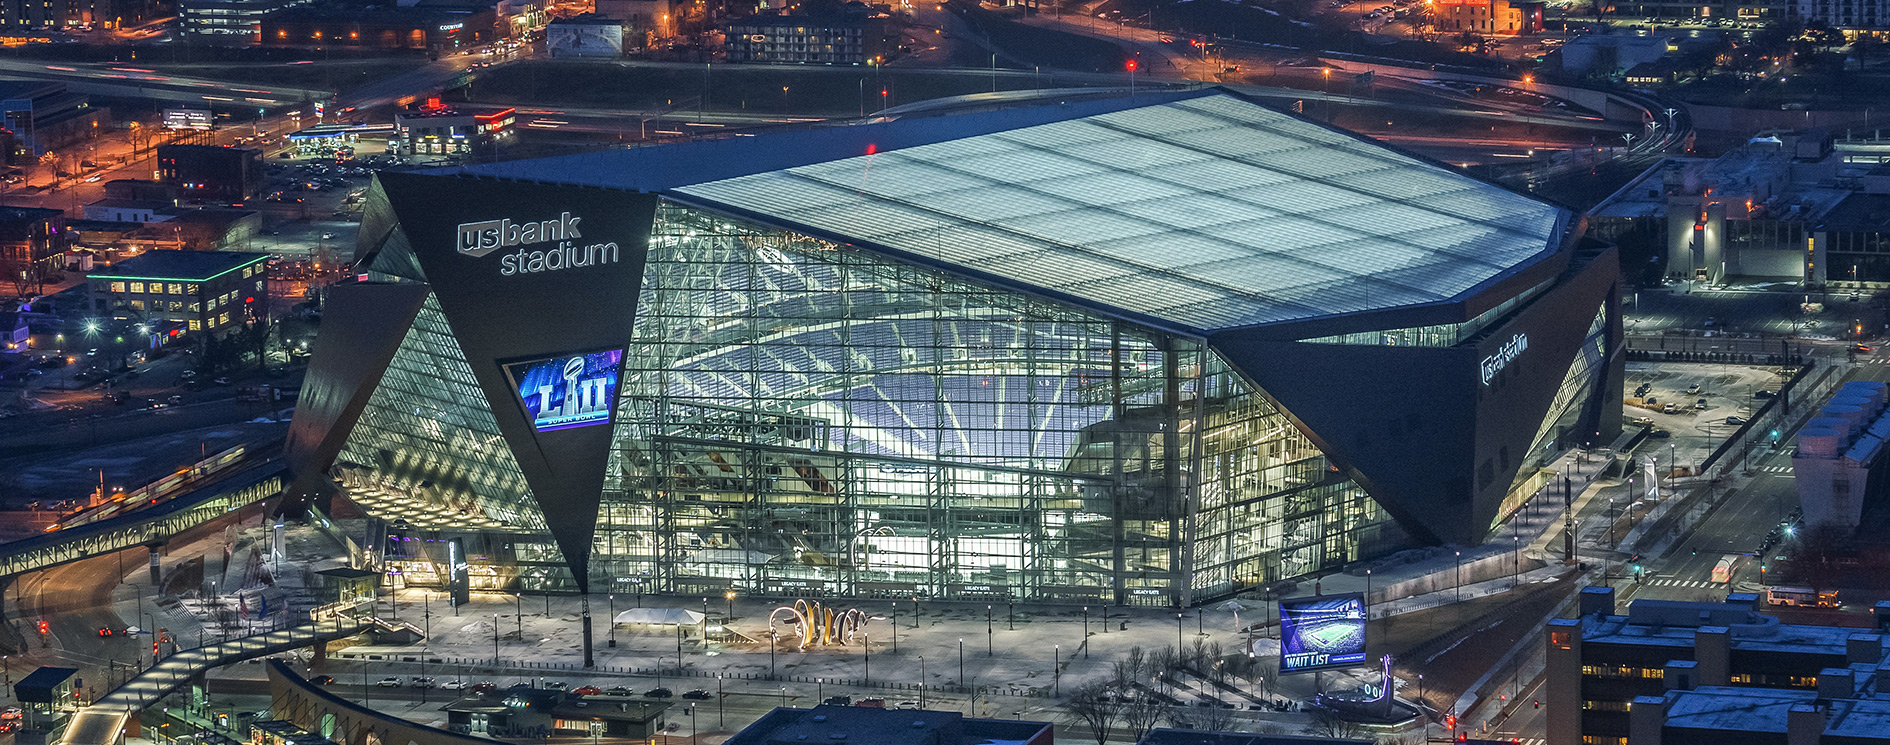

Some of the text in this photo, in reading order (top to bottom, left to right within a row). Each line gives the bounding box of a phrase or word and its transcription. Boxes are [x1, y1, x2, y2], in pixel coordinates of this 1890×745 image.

[459, 211, 582, 252] usbank
[500, 241, 619, 276] stadium
[547, 413, 596, 425] SUPER BOWL
[1286, 656, 1310, 668] WAIT
[1310, 653, 1330, 666] LIST
